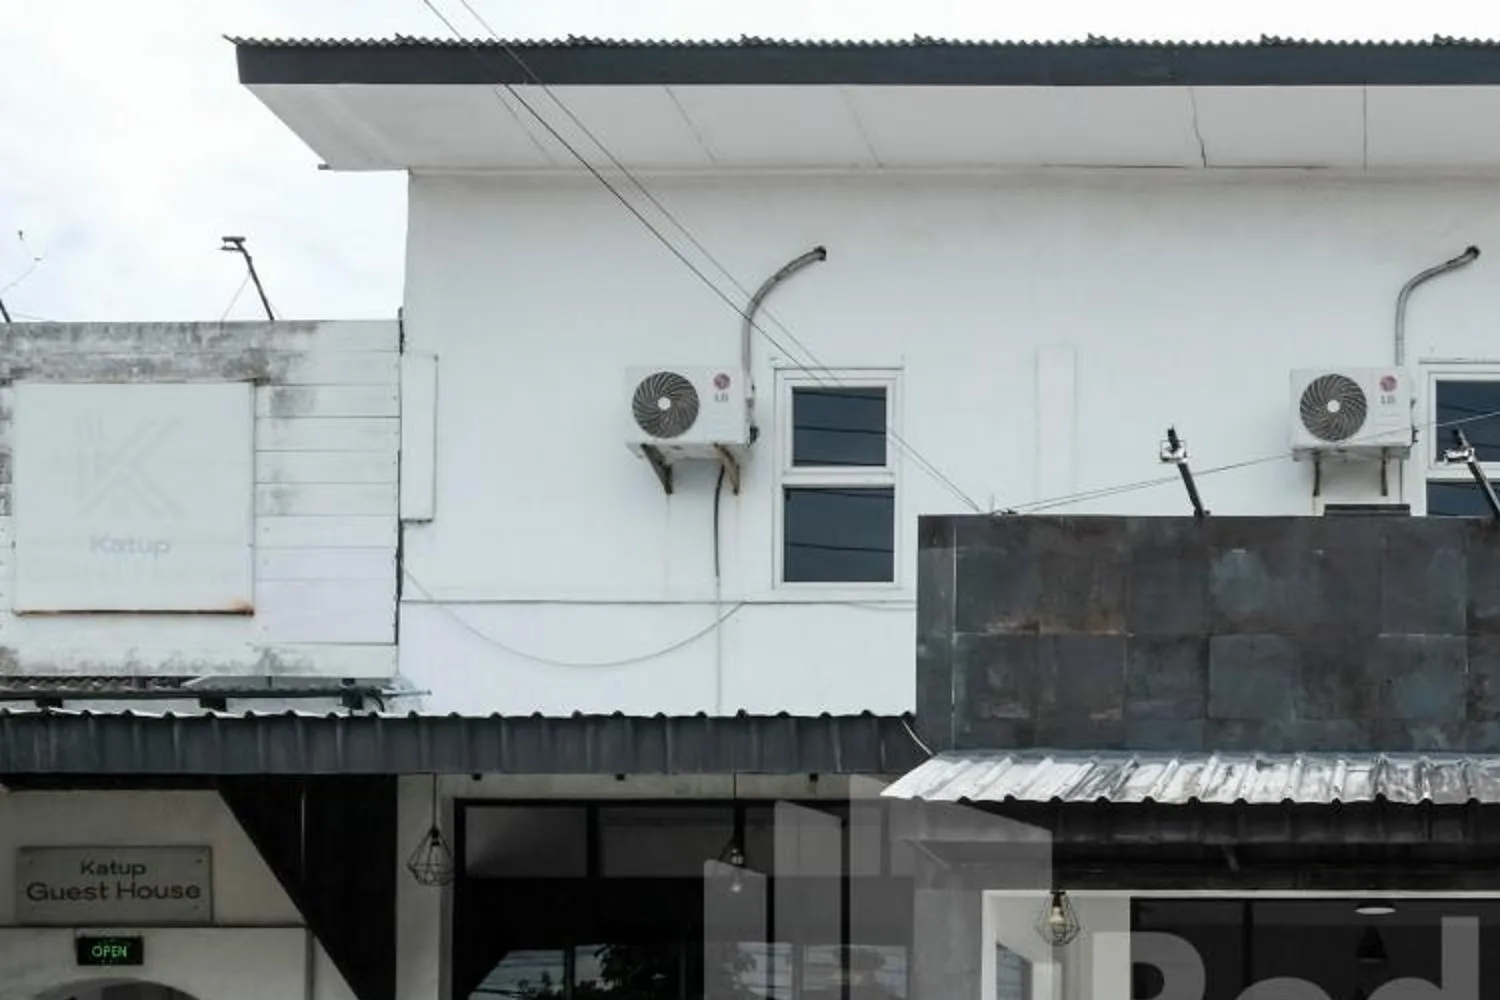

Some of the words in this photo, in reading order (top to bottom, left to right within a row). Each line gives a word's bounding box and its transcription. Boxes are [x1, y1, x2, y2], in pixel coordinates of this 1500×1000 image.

[89, 535, 172, 559] Katup
[80, 860, 147, 880] Katup
[26, 881, 109, 901] Guest
[117, 881, 202, 900] House
[91, 945, 128, 958] OPEN
